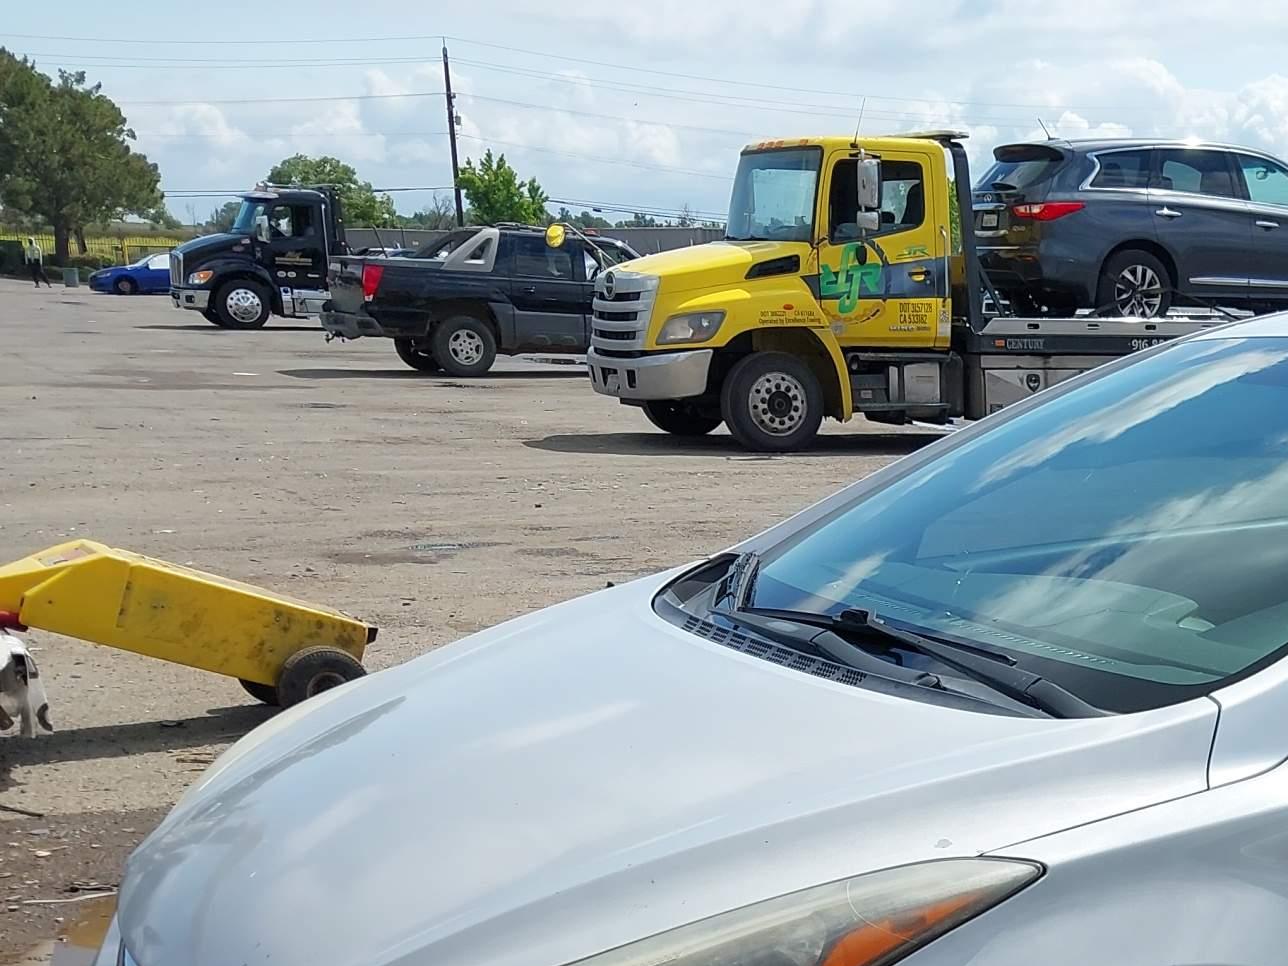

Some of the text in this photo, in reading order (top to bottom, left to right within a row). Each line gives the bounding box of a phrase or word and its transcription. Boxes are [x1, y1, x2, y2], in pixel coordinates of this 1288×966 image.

[899, 302, 911, 313] DOT
[899, 314, 907, 324] CA
[1007, 338, 1045, 350] CENTURY
